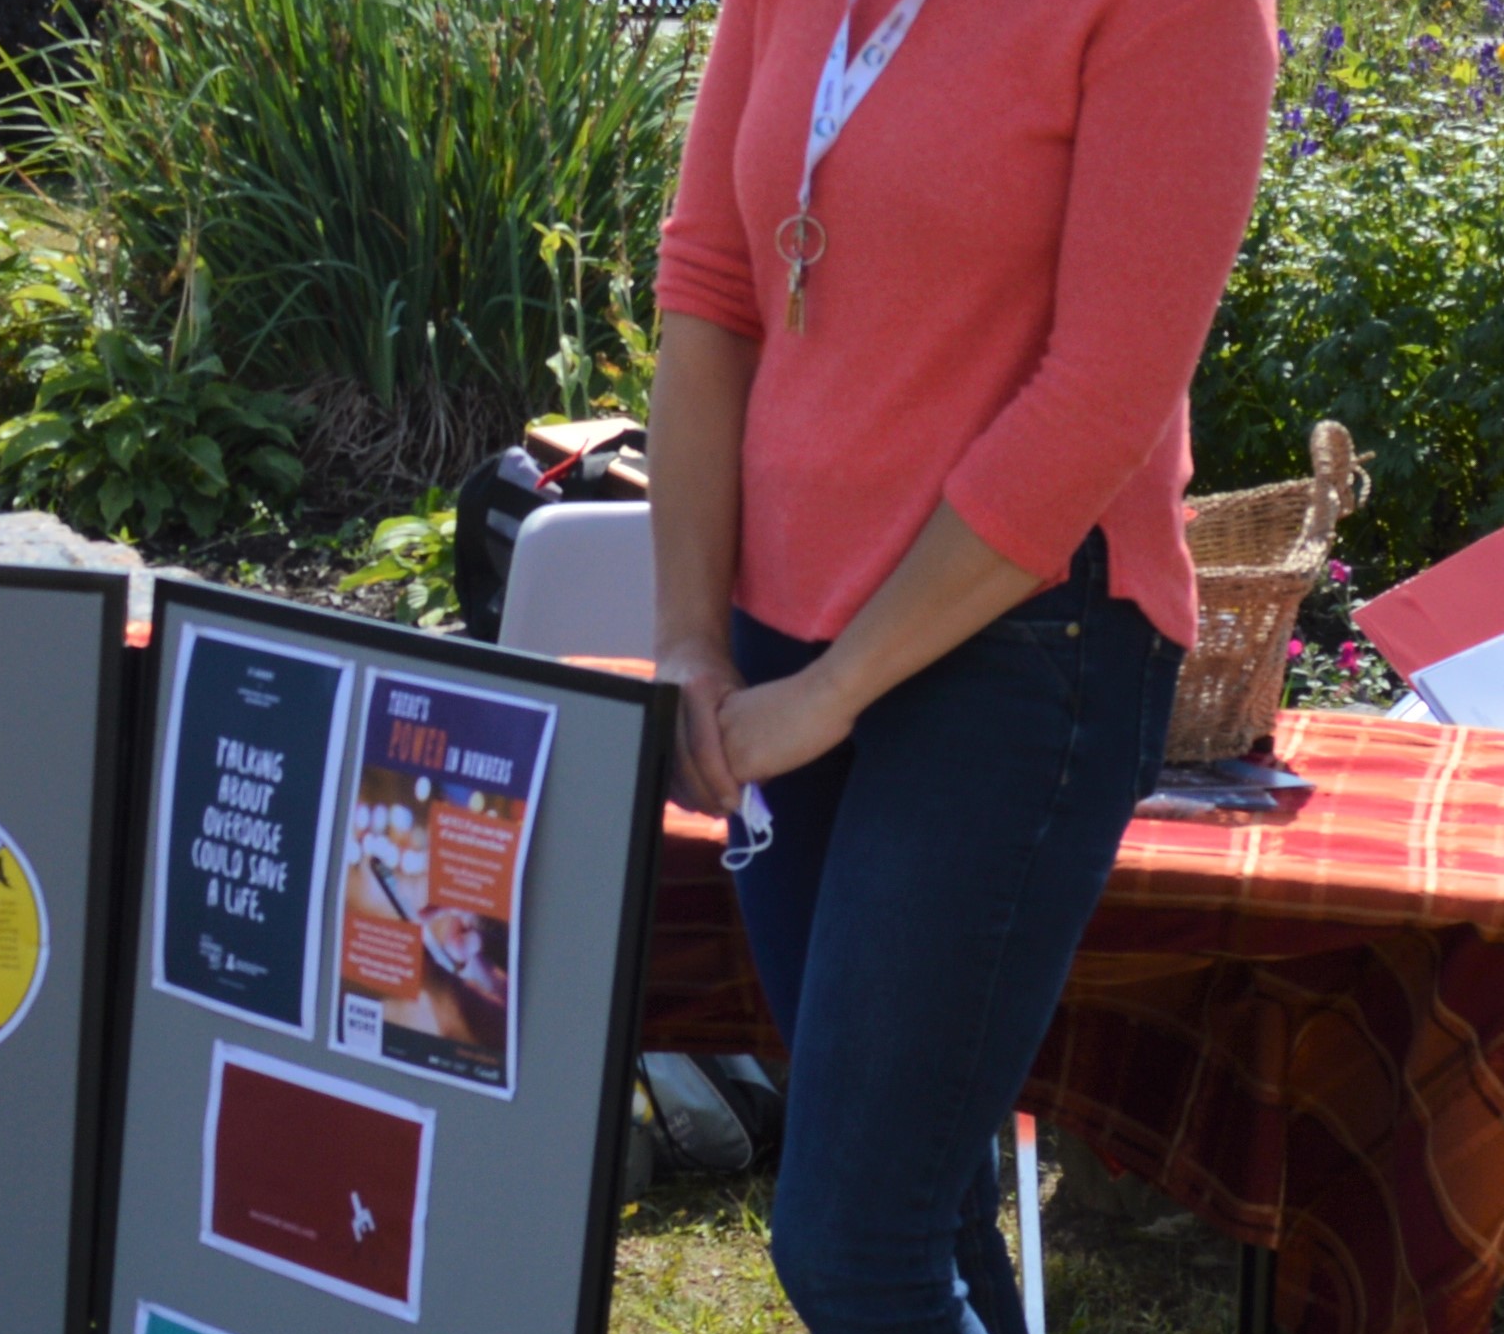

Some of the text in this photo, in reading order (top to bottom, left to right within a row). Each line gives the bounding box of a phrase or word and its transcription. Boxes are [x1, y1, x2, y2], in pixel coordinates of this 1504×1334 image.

[387, 689, 432, 722] THERE'S
[388, 719, 514, 786] POWER IN NUMBERS
[218, 772, 275, 816] ABOUT
[203, 804, 283, 855] OVERDOSE
[191, 836, 289, 893] COULD SAVE
[206, 877, 219, 907] A
